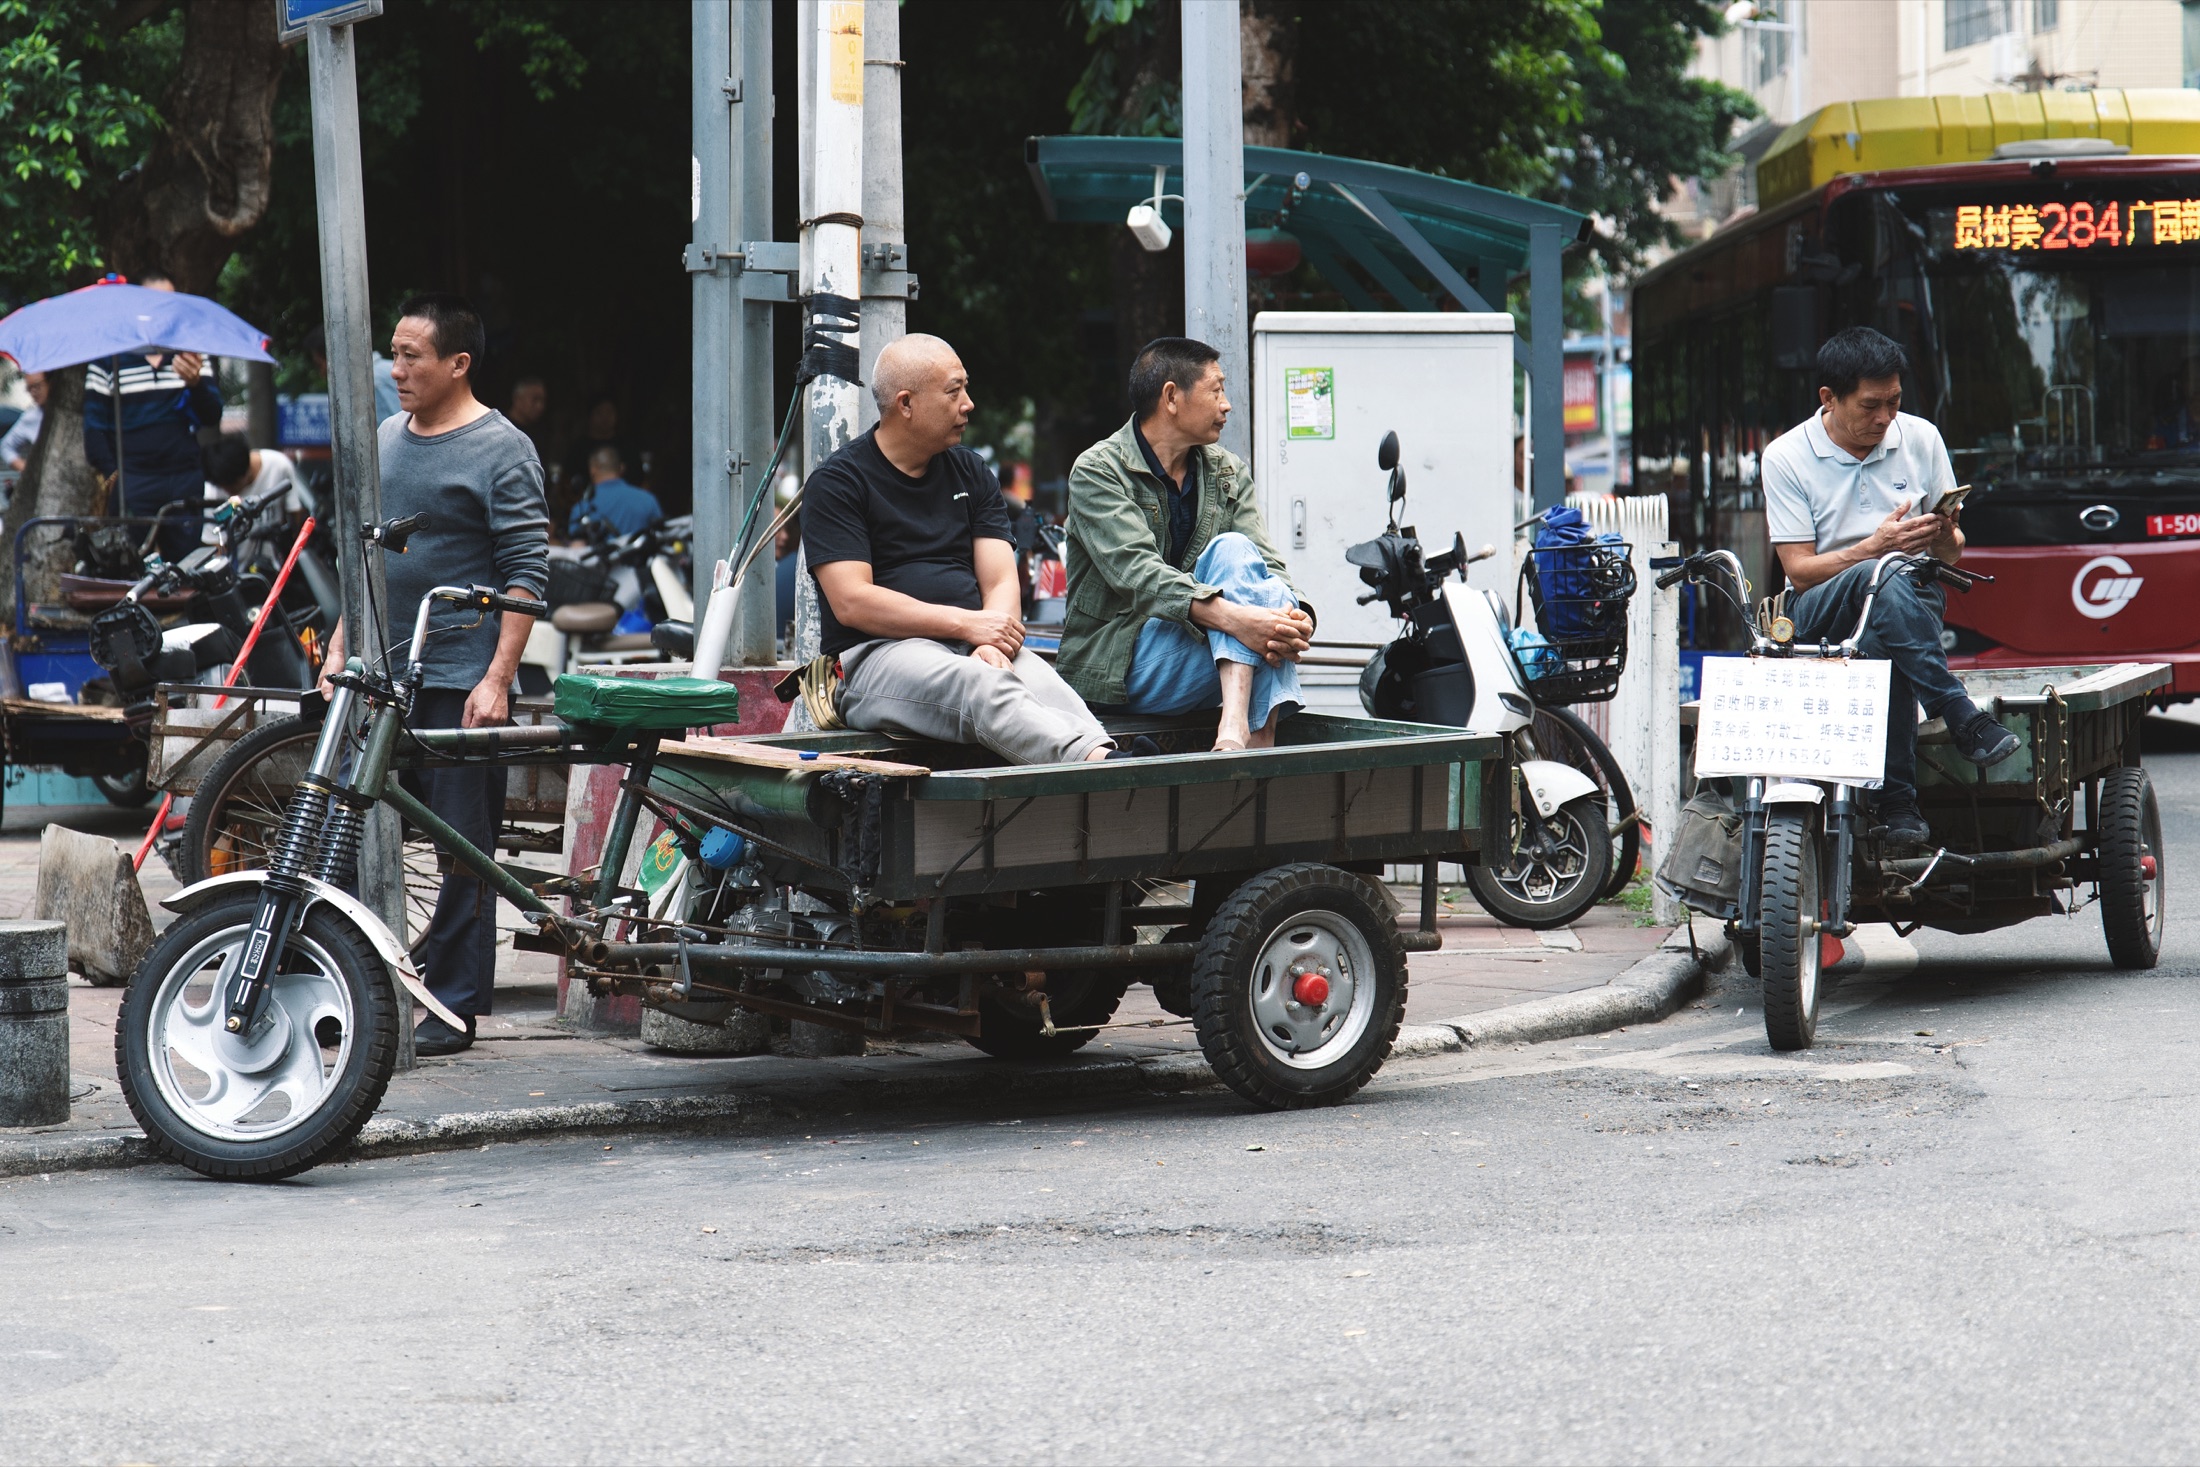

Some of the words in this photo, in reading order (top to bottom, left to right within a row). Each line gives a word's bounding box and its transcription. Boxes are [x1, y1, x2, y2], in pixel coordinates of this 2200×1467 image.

[1954, 204, 2043, 250] 员村美
[2040, 201, 2122, 249] 284
[2153, 514, 2200, 534] 1-50
